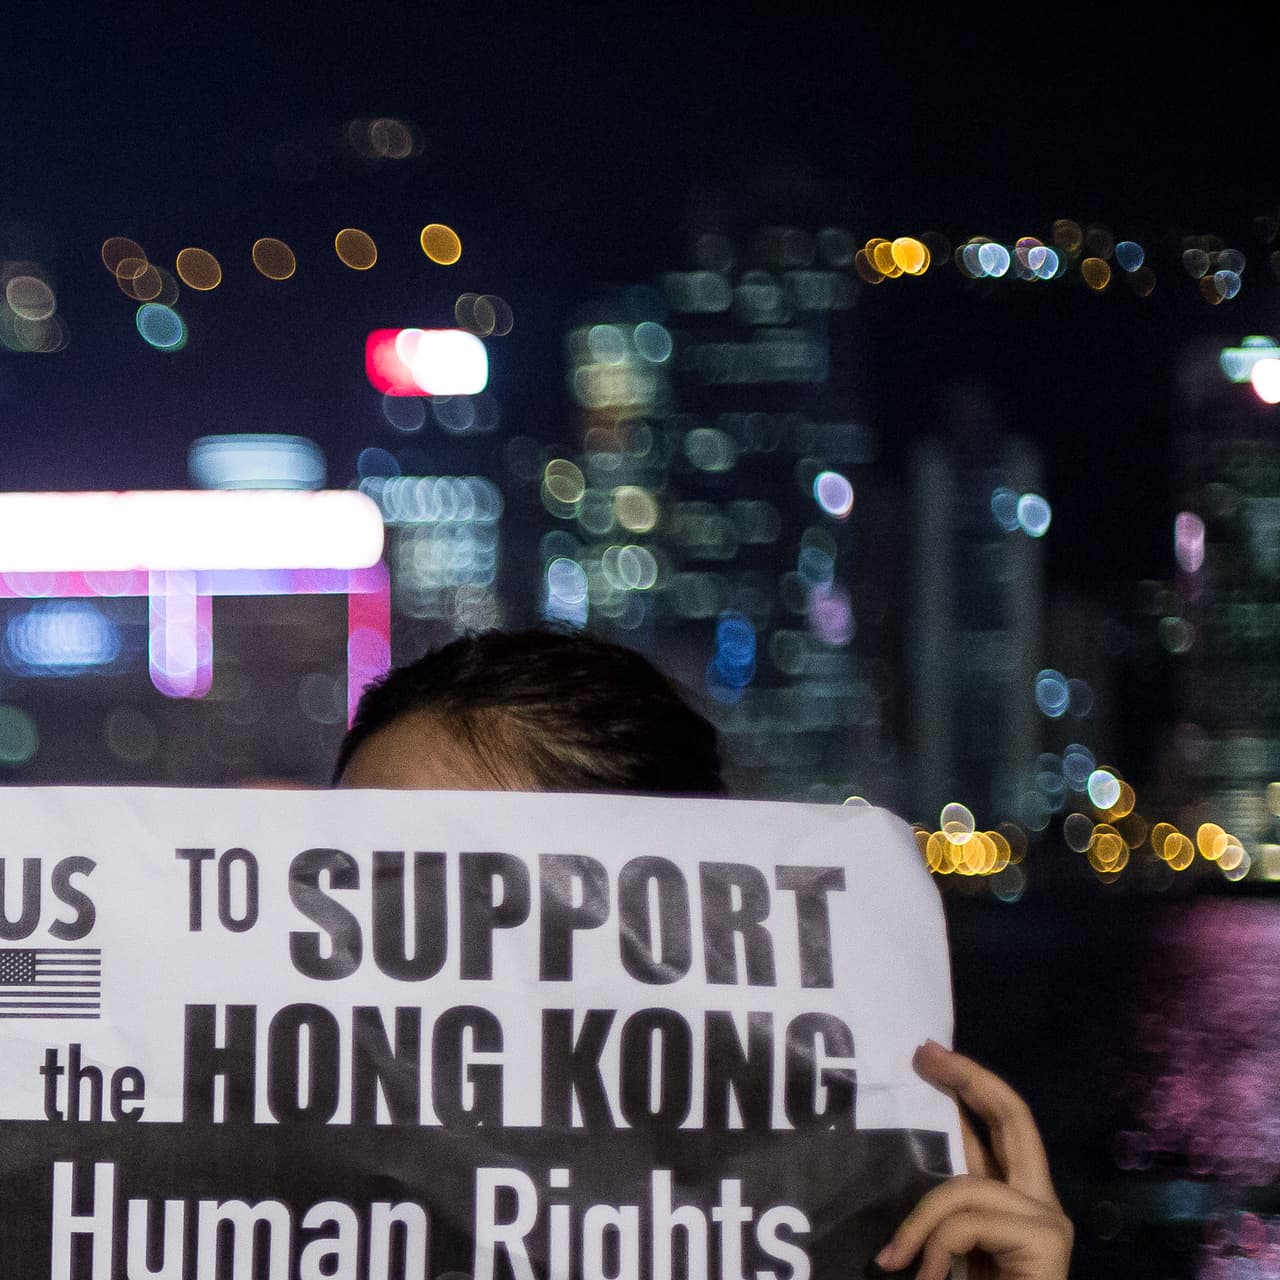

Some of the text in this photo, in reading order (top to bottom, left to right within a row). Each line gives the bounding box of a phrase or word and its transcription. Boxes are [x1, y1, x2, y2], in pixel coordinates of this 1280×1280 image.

[175, 847, 260, 932] TO
[288, 847, 847, 990] SUPPORT
[40, 1003, 857, 1130] the HONG KONG
